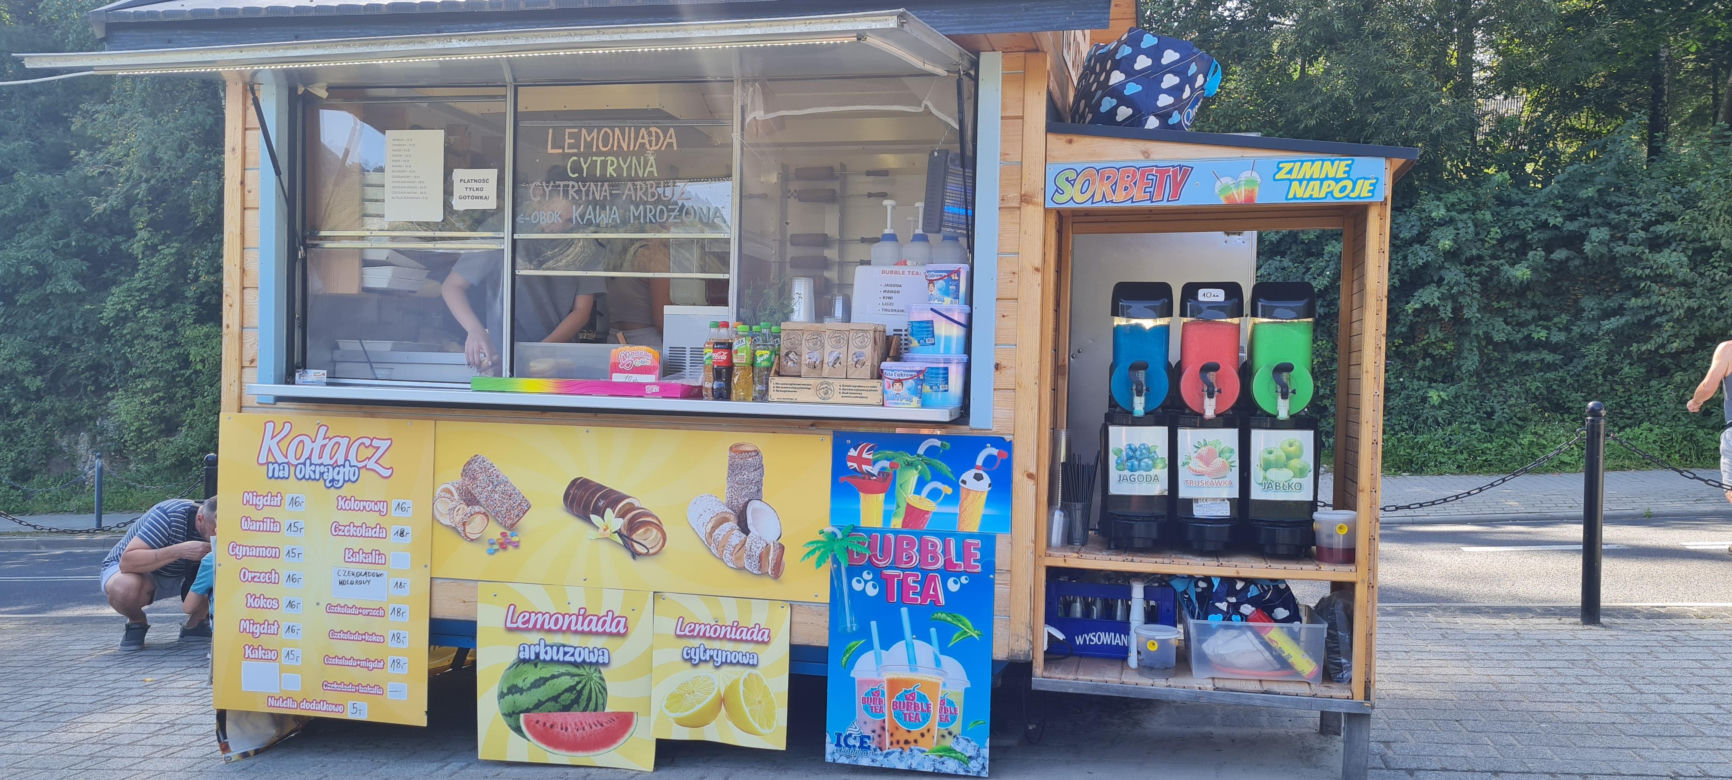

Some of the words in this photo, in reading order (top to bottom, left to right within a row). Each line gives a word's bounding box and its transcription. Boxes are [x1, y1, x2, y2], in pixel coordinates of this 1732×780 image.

[547, 126, 678, 154] LEMONIADA
[567, 155, 658, 178] CYTRYNA
[1274, 158, 1355, 181] ZIMNE
[1051, 165, 1193, 204] SORBETY
[1287, 177, 1379, 200] NAPOJE
[531, 211, 562, 225] OBOK
[572, 205, 620, 225] KAWA
[257, 420, 393, 478] Kołacz
[267, 462, 289, 479] na
[1117, 473, 1160, 484] JAGODA
[1184, 479, 1233, 488] TRUSKAWKA
[1262, 482, 1303, 492] JABŁKO
[337, 495, 388, 515] Kolorowy
[241, 516, 281, 533] Wanilia
[331, 521, 387, 539] Czekolada
[228, 541, 280, 560] Cynamon
[344, 548, 386, 565] Bakalia
[847, 533, 981, 573] BUBBLE
[239, 567, 279, 584] Orzech
[881, 570, 945, 606] TEA
[246, 593, 279, 609] Kokos
[239, 619, 279, 638] Migdał
[505, 604, 627, 635] Lemoniada
[675, 617, 771, 643] Lemoniada
[1075, 631, 1128, 647] WYSOWIAN
[244, 645, 278, 660] Kakao
[518, 639, 610, 665] arbuzowa
[682, 644, 759, 667] cytrynowa
[267, 697, 297, 709] Nutella
[300, 699, 344, 713] dodatkowo
[862, 697, 885, 705] BUBB
[870, 705, 884, 714] TEA
[891, 700, 932, 713] BUBBLE
[902, 712, 922, 723] TEA
[834, 732, 871, 749] ICE
